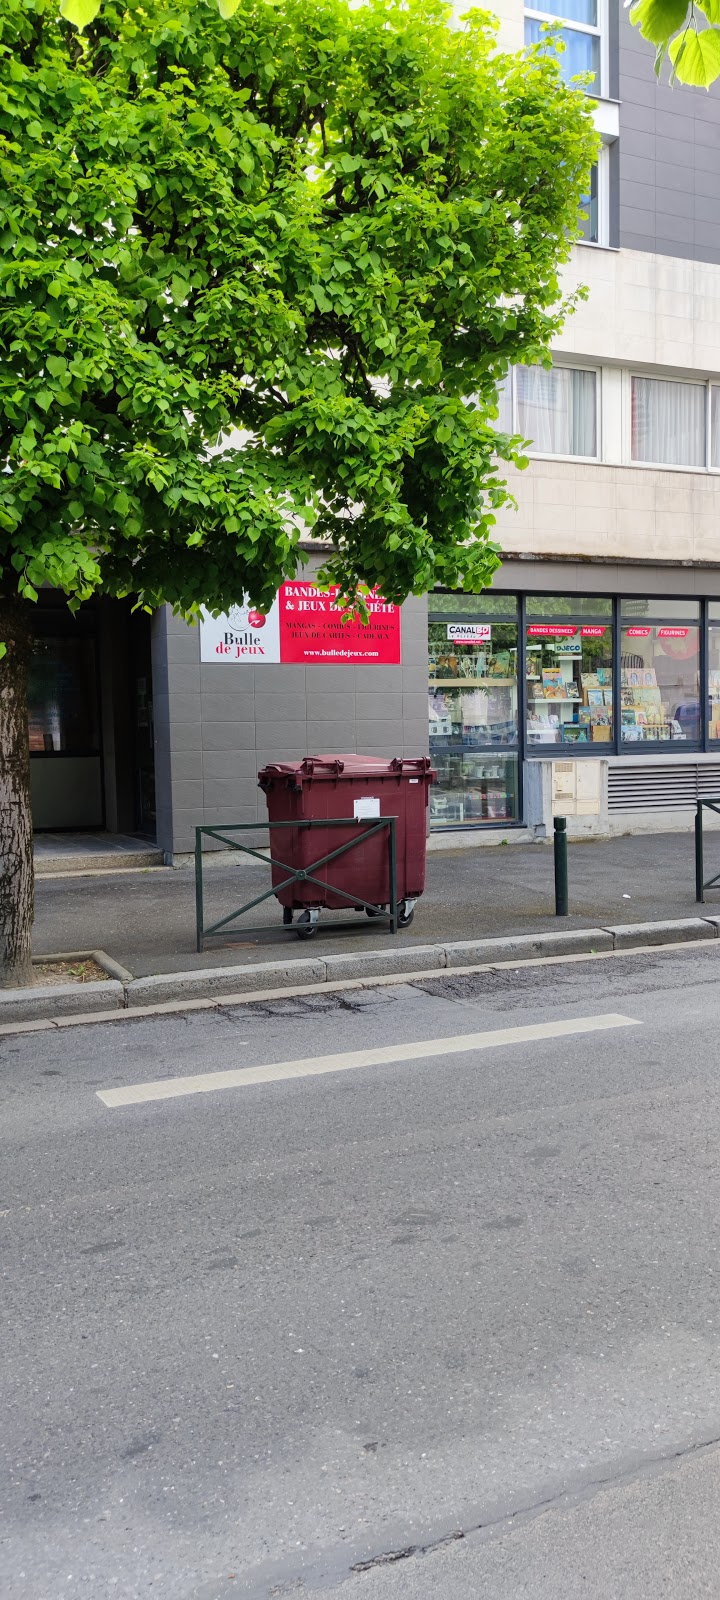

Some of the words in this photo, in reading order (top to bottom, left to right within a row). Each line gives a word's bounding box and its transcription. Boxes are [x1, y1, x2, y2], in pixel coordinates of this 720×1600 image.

[285, 600, 294, 611] &
[298, 600, 326, 611] JEUX
[323, 622, 351, 630] COMICS
[449, 626, 475, 634] CANAL
[476, 626, 490, 635] BD
[224, 632, 260, 645] Bulle
[292, 631, 309, 639] JEUX
[323, 632, 350, 640] CARTES
[215, 641, 231, 654] de
[235, 645, 265, 658] jeux
[303, 649, 379, 658] www.bulledejeux.com
